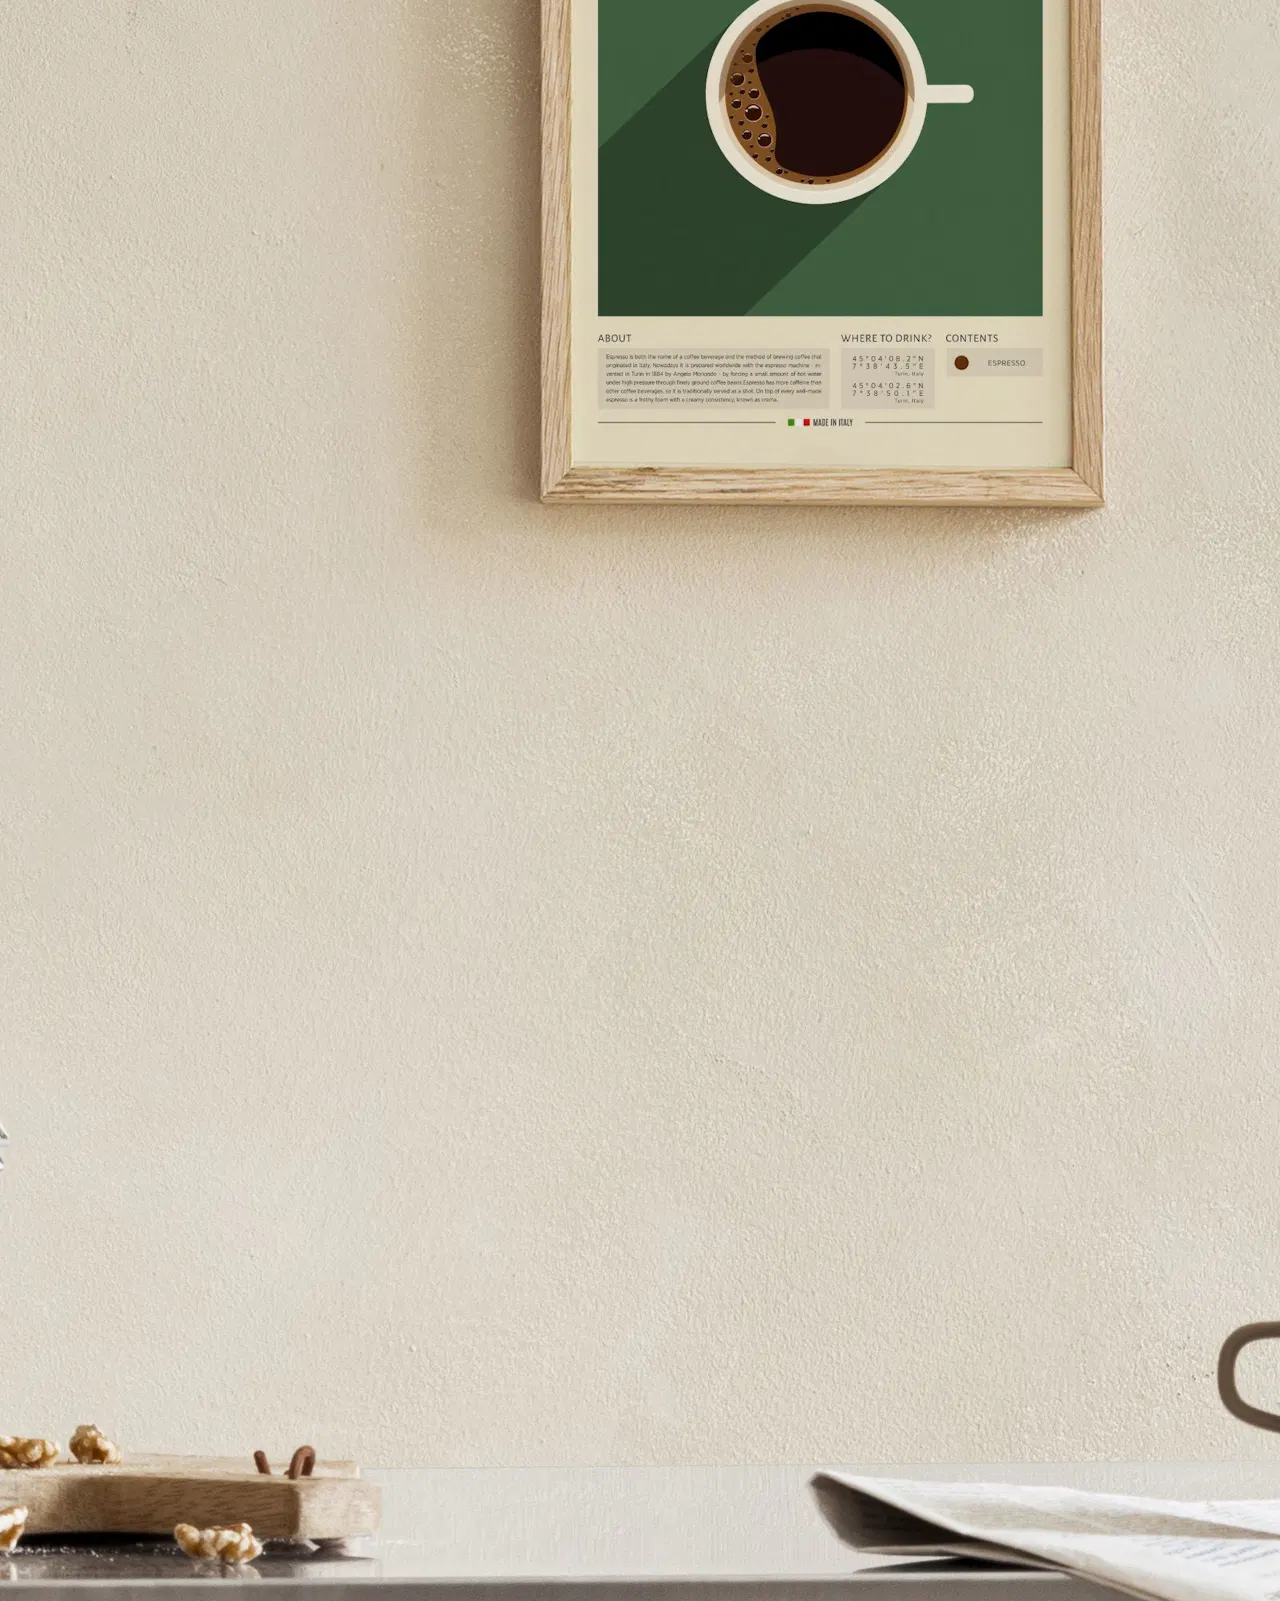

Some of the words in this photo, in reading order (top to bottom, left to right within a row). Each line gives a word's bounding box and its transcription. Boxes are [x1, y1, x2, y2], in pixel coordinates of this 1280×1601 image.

[597, 333, 632, 342] ABOUT
[840, 333, 878, 342] WHERE
[880, 333, 893, 342] TO
[895, 333, 932, 342] DRINK?
[945, 333, 999, 342] CONTENTS
[987, 359, 1026, 367] ESPRESSO
[812, 418, 829, 427] MADE
[830, 418, 837, 427] IN
[838, 418, 854, 427] ITALY
